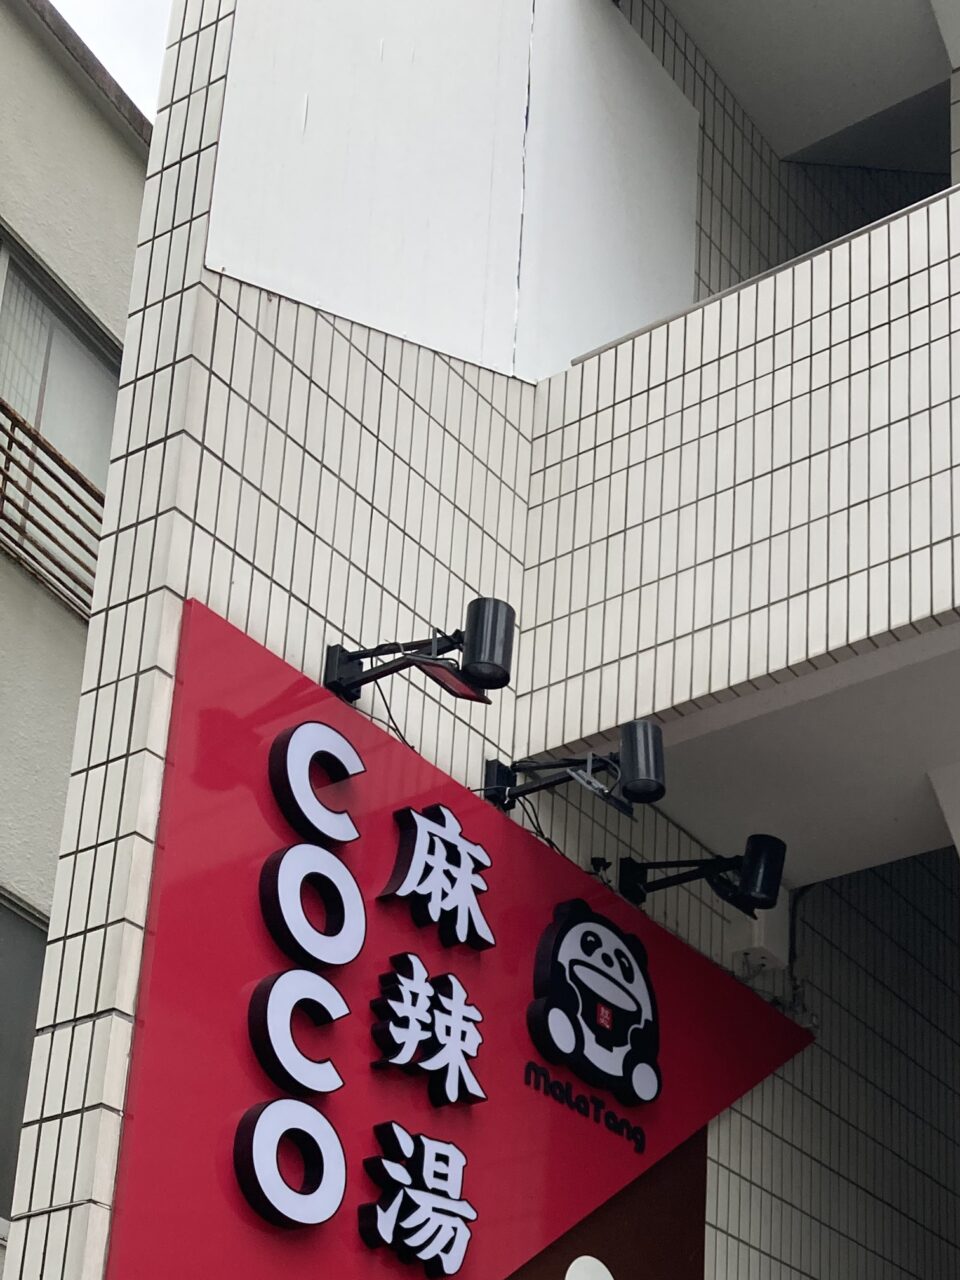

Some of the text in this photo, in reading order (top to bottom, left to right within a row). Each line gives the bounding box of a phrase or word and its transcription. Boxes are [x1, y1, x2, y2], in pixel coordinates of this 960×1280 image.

[250, 720, 367, 1226] COCO
[374, 803, 497, 1276] 麻辣湯
